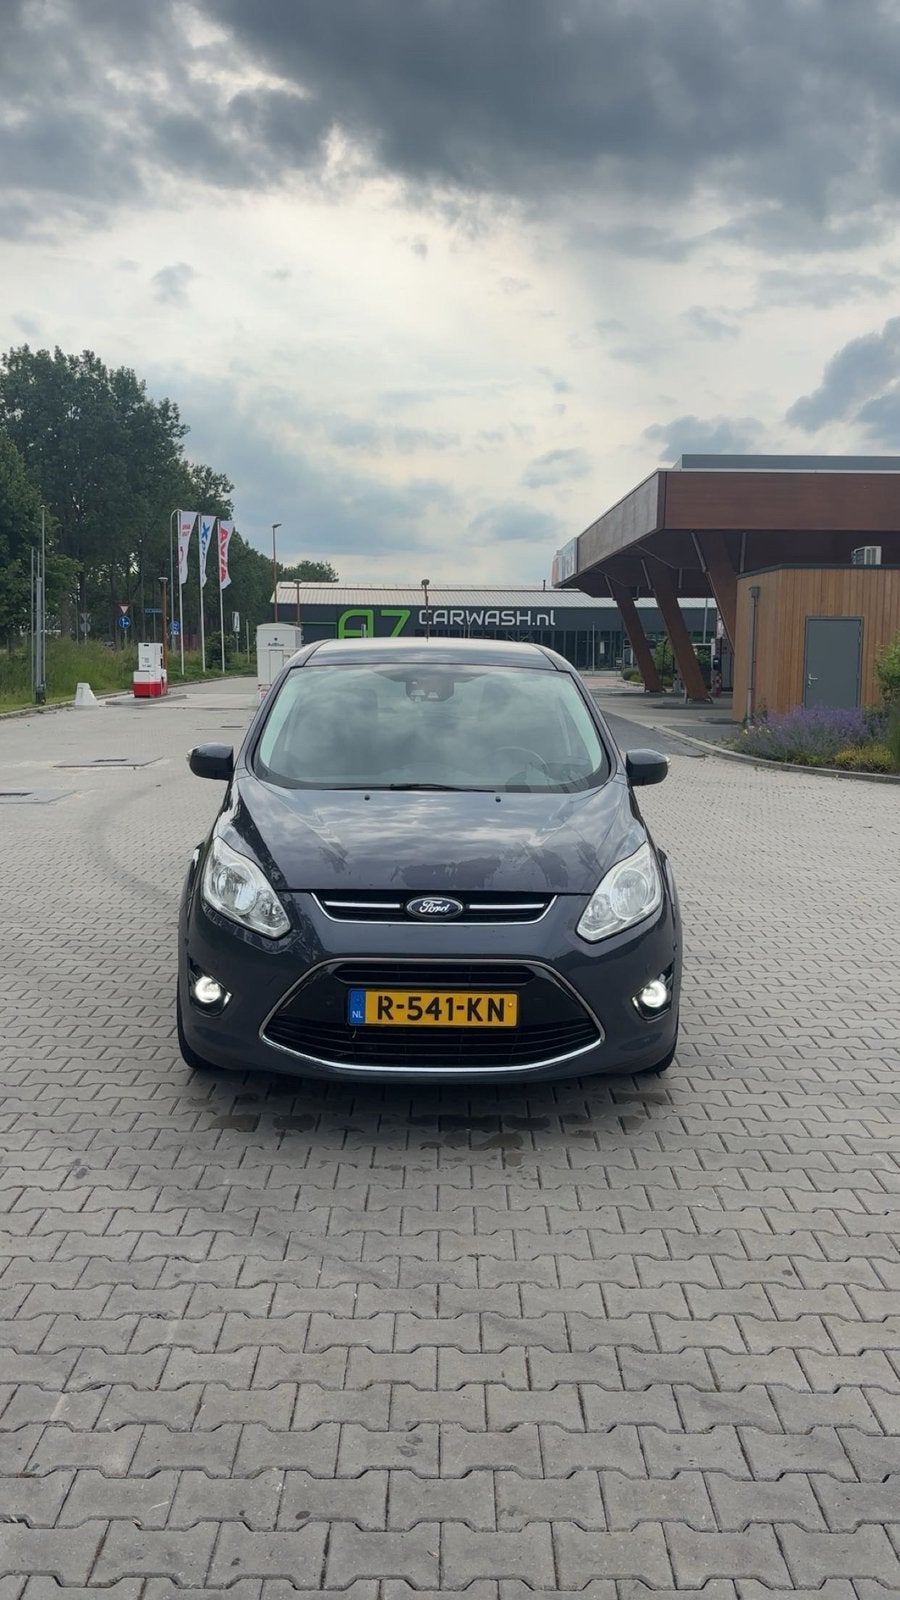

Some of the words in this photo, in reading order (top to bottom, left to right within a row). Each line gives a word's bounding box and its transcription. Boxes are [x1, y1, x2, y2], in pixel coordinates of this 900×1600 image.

[219, 527, 229, 583] AVIA
[338, 609, 411, 638] A7
[418, 609, 556, 626] CARWASH.nl
[419, 899, 451, 914] Ford
[352, 1010, 363, 1019] NL
[377, 995, 505, 1022] R-541-KN
